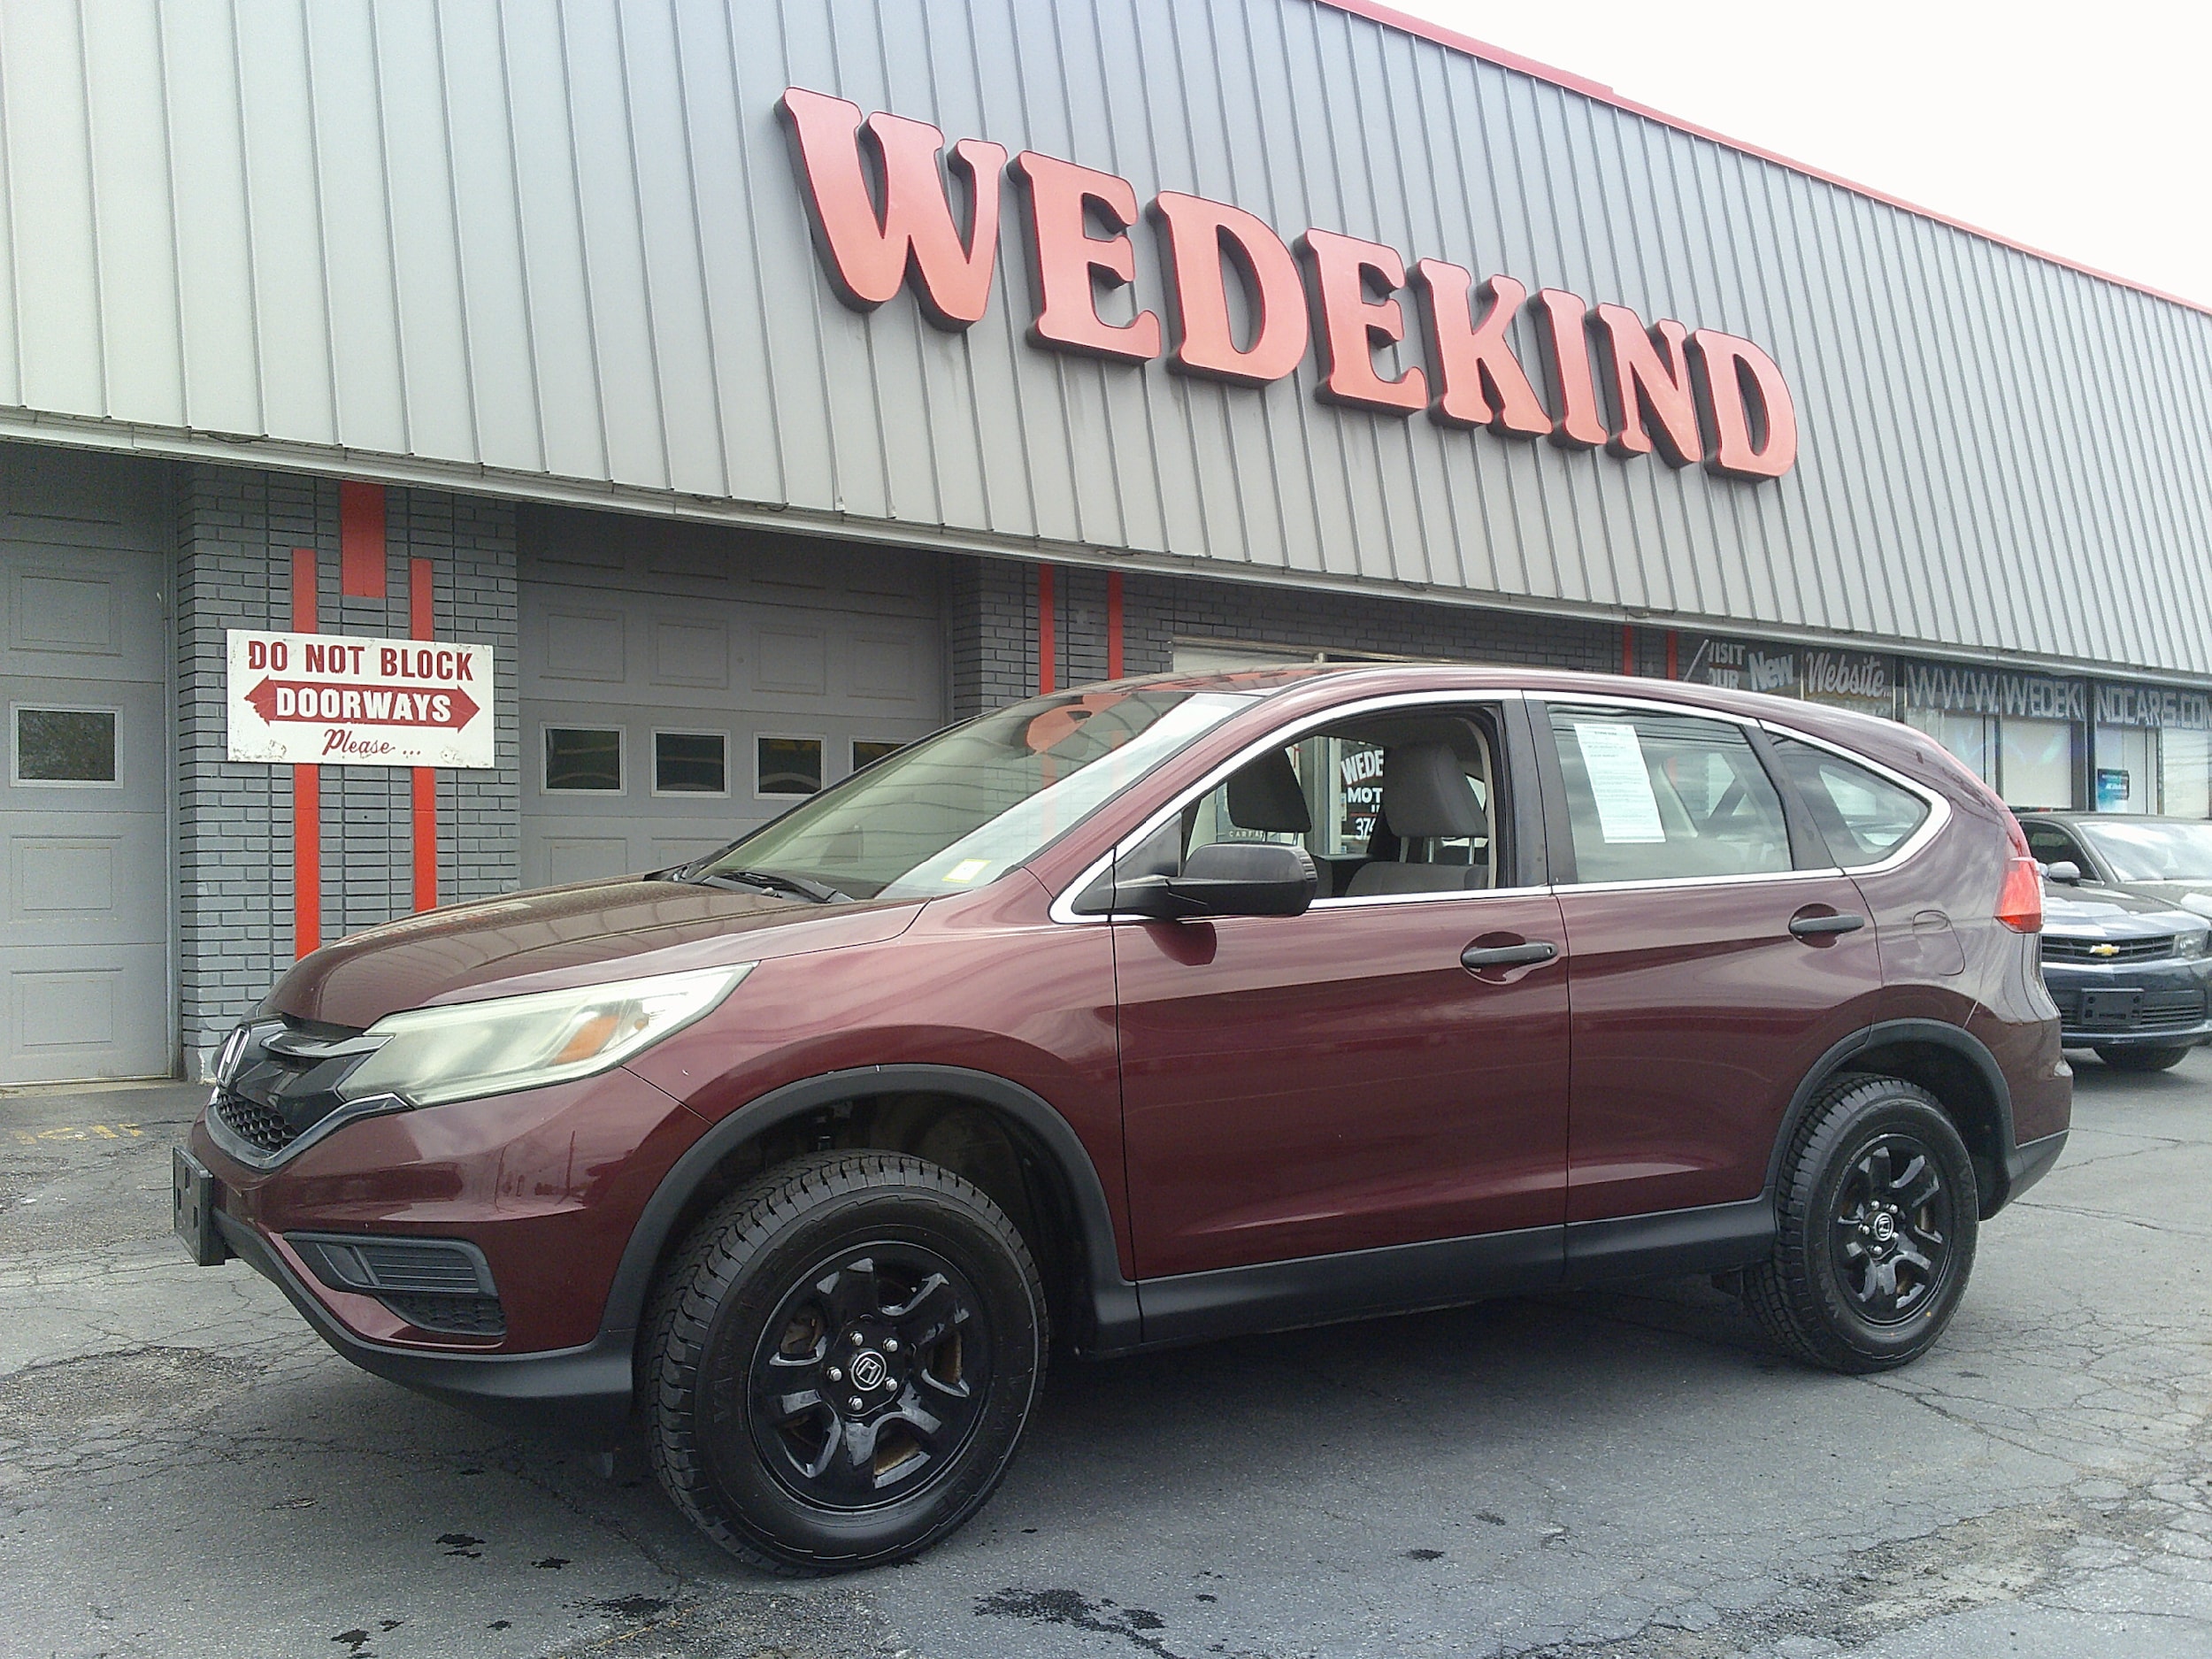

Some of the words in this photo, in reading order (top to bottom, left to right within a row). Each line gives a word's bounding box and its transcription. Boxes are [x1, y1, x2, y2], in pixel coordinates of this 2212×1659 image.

[777, 87, 1798, 483] WEDEKIND
[248, 641, 288, 672] DO
[305, 644, 365, 675] NOT
[380, 648, 473, 681] BLOCK
[276, 687, 451, 723] DOORWAYS
[321, 728, 396, 757] Please
